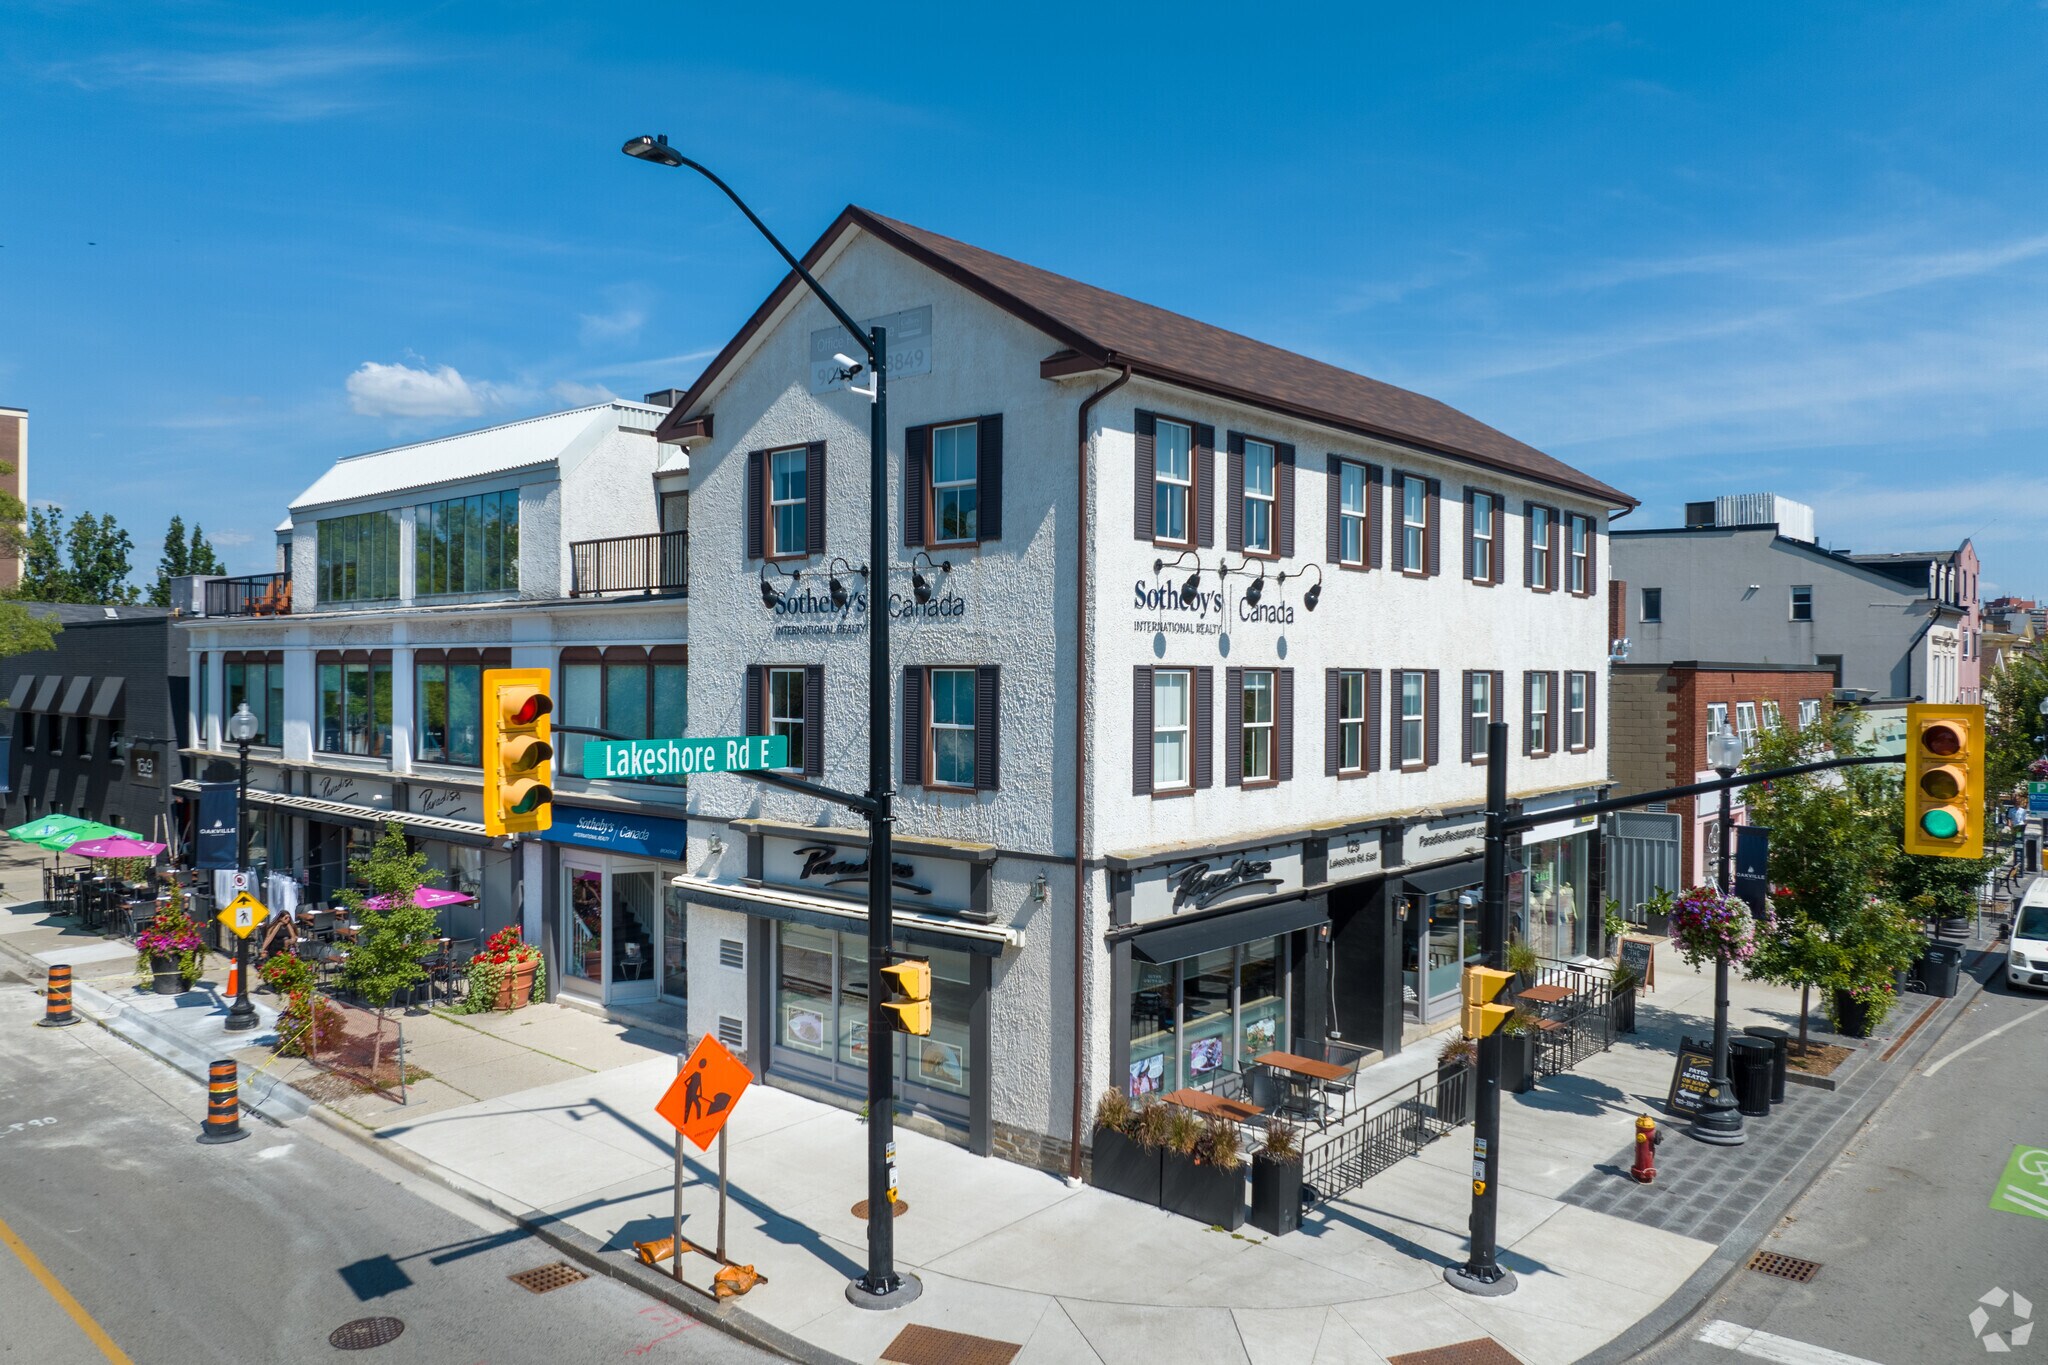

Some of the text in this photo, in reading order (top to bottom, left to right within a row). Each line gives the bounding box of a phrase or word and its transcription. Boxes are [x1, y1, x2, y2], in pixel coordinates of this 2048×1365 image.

[889, 592, 965, 619] Canada
[1239, 597, 1294, 624] Canada
[775, 623, 867, 636] INTERNATIONAL REALTY
[1134, 621, 1222, 635] INTERNATIONAL REALTY
[606, 738, 770, 776] Lakeshore Rd E
[2036, 783, 2047, 793] P
[419, 788, 461, 812] Paradiso
[200, 827, 236, 835] OAKVILLE
[576, 816, 650, 841] Sotheby's Canada
[1347, 839, 1360, 854] 125
[1737, 872, 1766, 880] OAKVILLE
[1688, 1067, 1709, 1076] PATIO
